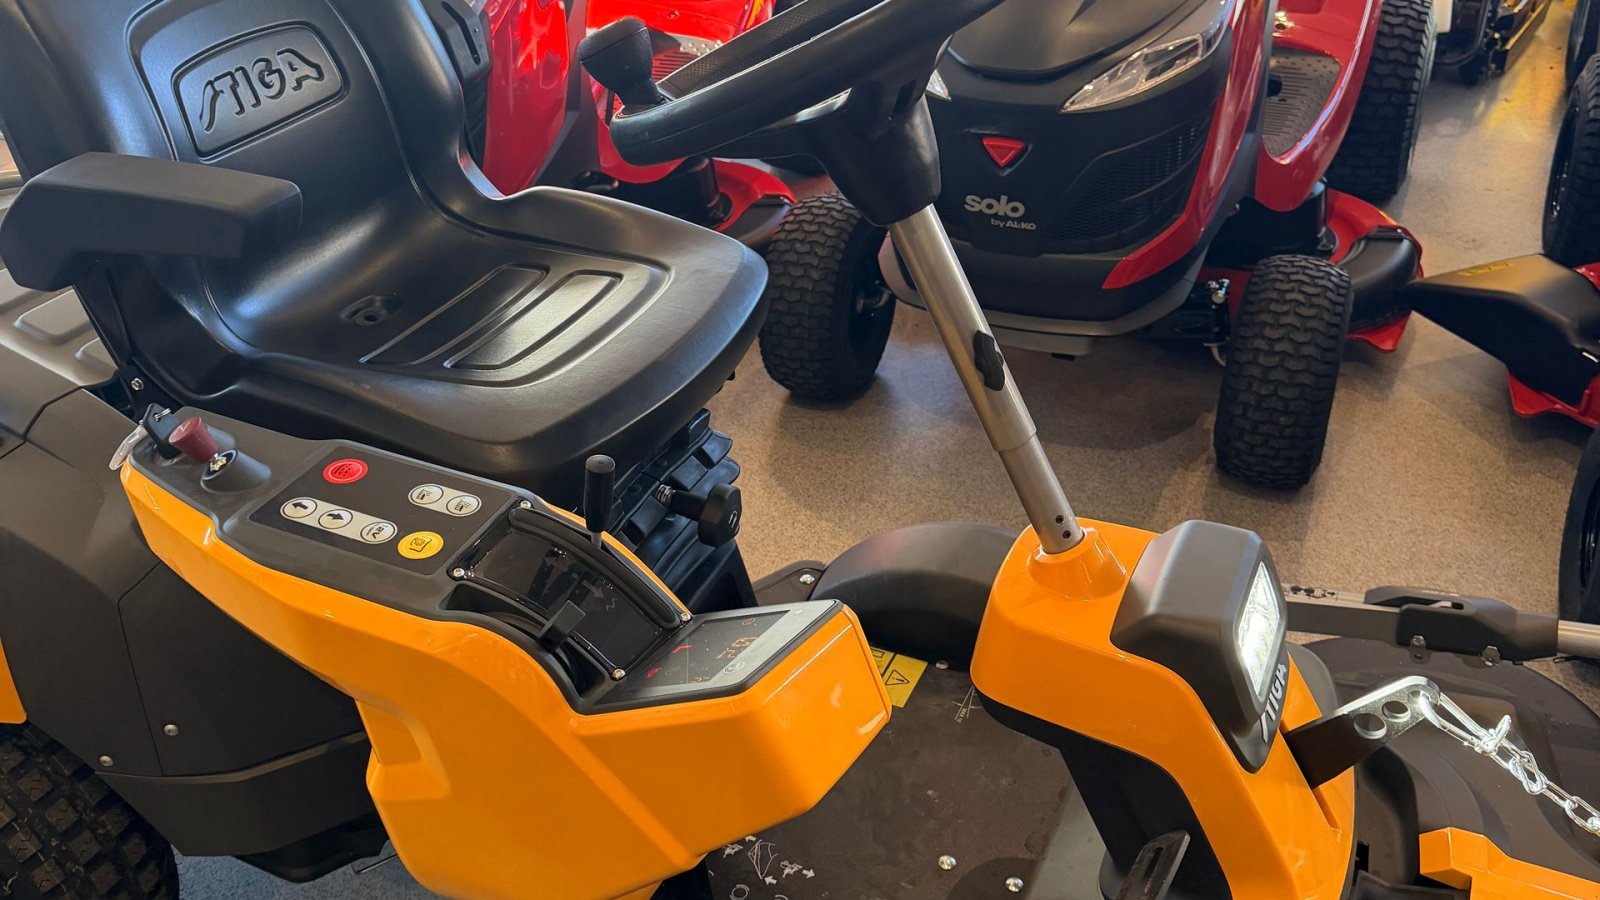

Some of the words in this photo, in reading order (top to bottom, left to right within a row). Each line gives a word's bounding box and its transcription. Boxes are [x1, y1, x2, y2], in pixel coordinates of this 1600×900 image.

[200, 48, 324, 132] STIGA
[964, 195, 1025, 218] solo
[991, 217, 1004, 228] by
[1260, 663, 1287, 743] STIGA
